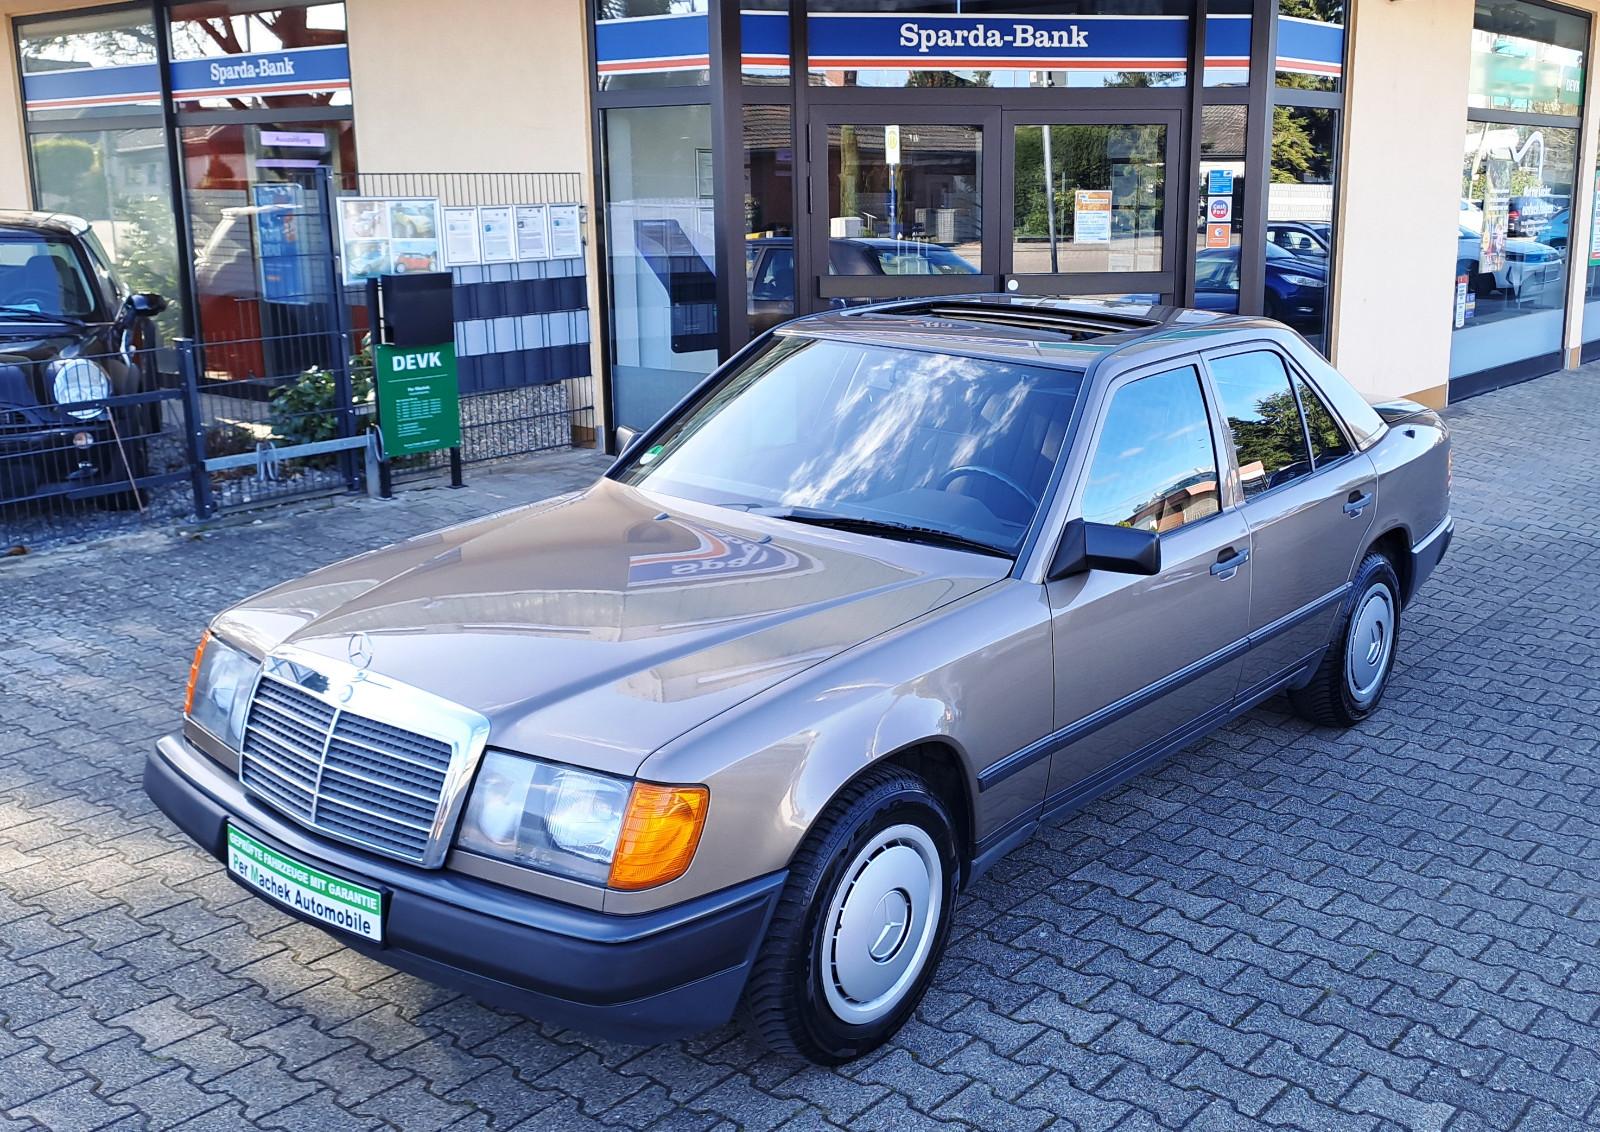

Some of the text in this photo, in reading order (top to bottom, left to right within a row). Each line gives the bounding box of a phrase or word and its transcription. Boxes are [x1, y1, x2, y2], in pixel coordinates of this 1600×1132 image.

[900, 23, 1089, 52] Sparda-Bank
[210, 57, 295, 84] Sparda-Bank
[392, 351, 442, 371] DEVK
[229, 832, 378, 911] GEPRÜFTE FAHRZEUGE MIT GARANTIE
[233, 853, 371, 935] Per Machek Automobile
